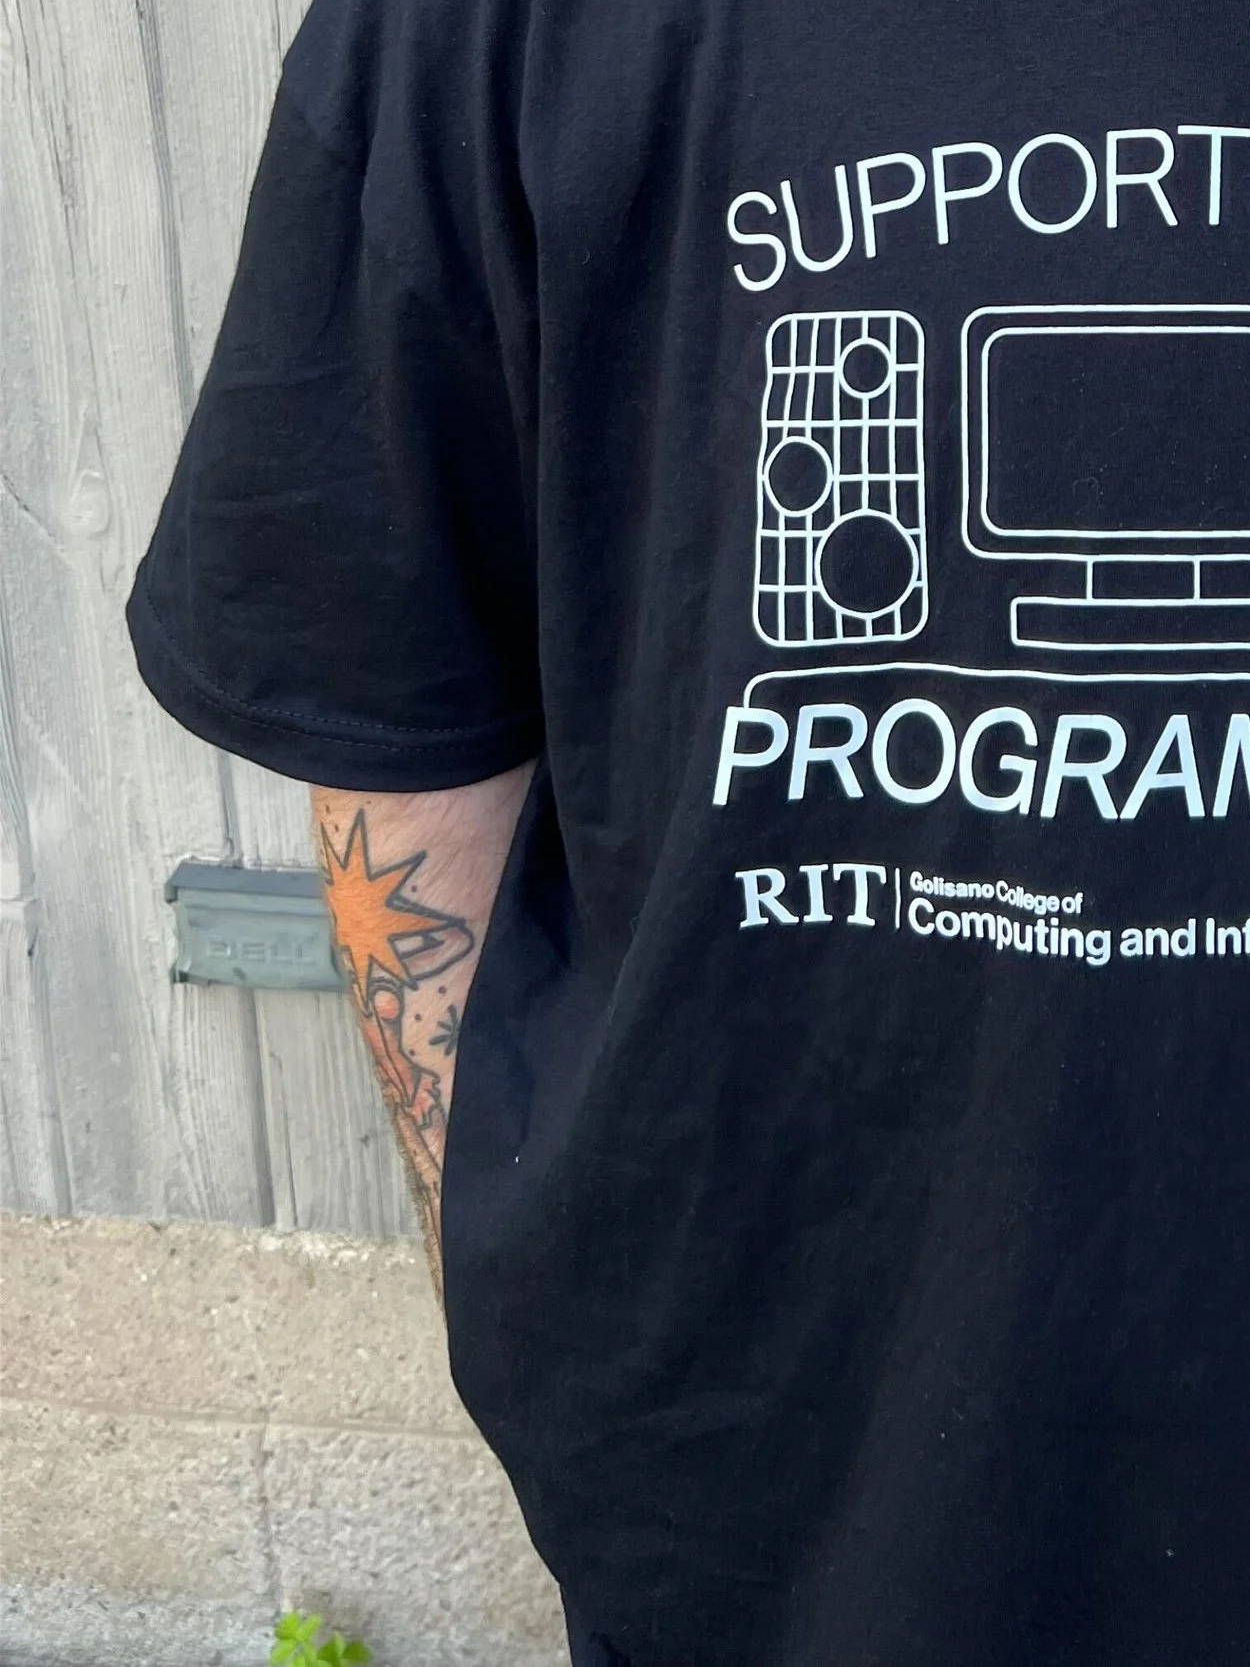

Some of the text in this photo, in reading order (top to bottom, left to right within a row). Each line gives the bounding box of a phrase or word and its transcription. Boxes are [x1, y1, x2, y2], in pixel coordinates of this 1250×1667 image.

[734, 862, 887, 929] RIT
[909, 870, 1084, 916] Golisano College of
[907, 897, 1112, 967] Computing
[1119, 918, 1197, 958] and
